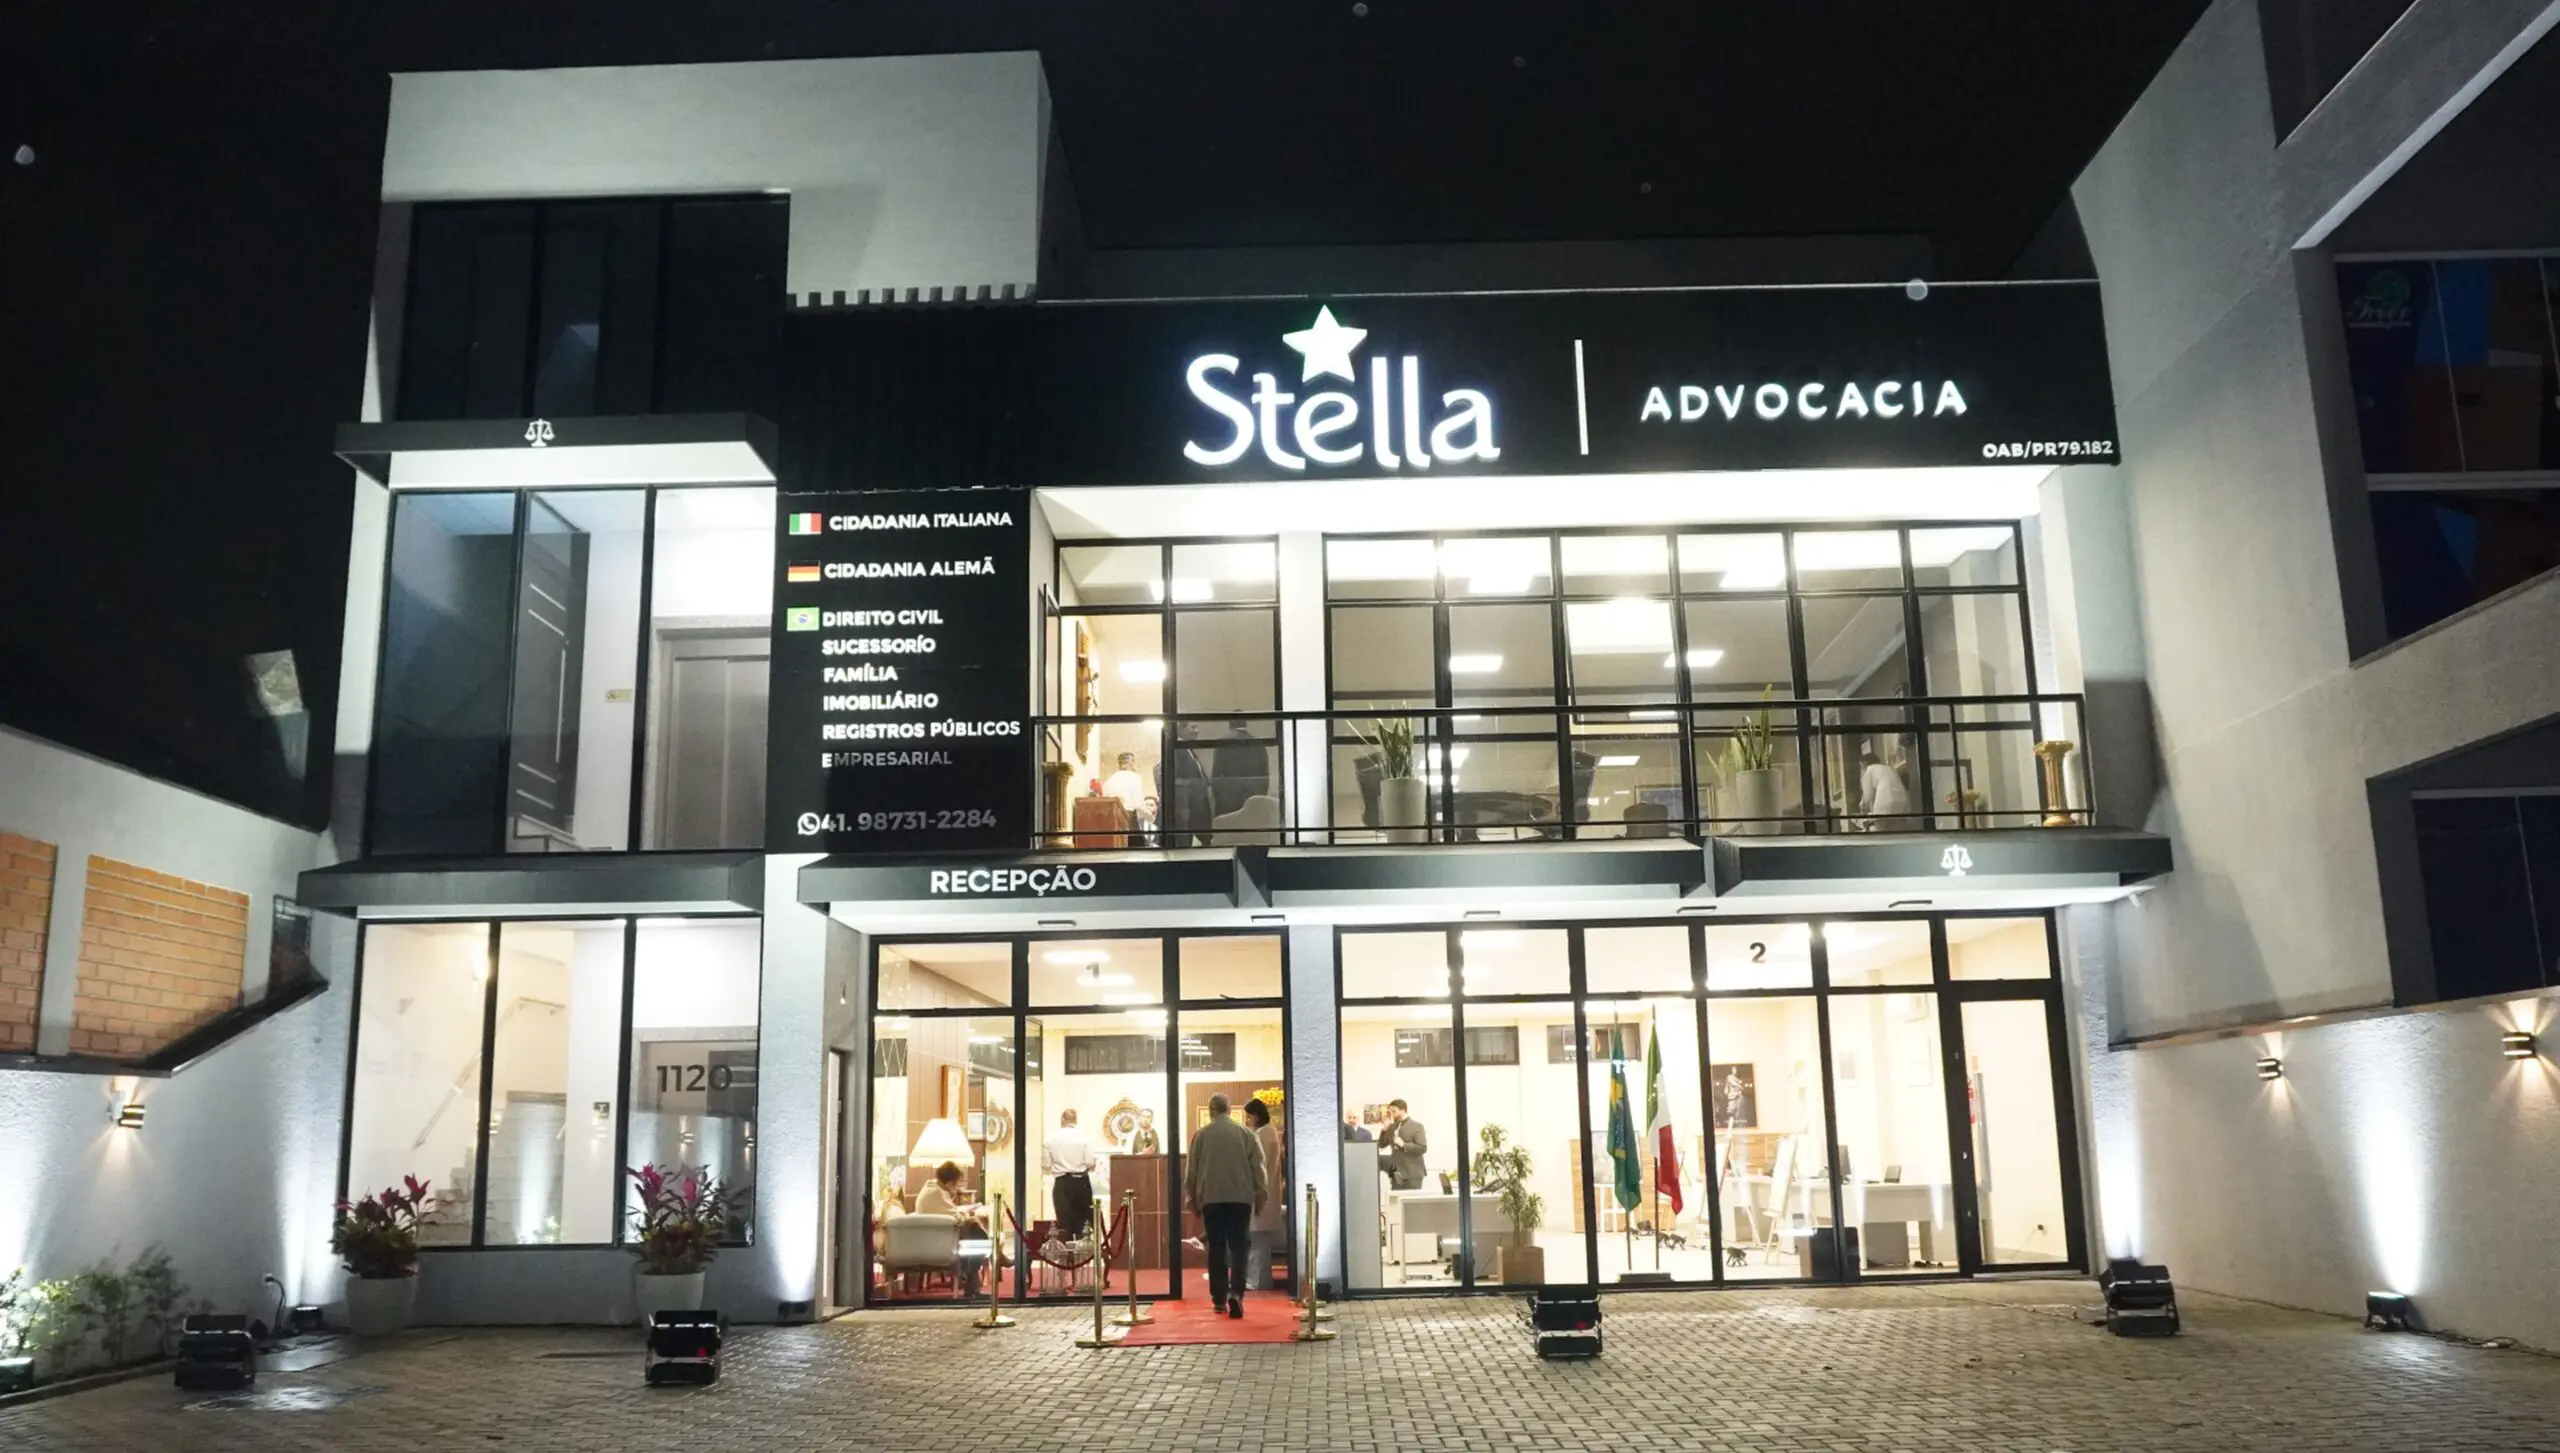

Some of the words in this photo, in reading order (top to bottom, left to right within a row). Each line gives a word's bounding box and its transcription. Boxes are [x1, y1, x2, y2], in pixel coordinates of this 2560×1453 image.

[1641, 380, 1967, 421] ADVOCACIA
[1184, 354, 1500, 469] Stella
[829, 514, 930, 531] CIDADANIA
[934, 512, 1012, 529] ITALIANA
[824, 562, 926, 579] CIDADANIA
[930, 556, 995, 577] ALEMÃ
[822, 610, 895, 627] DIREITO
[898, 610, 943, 625] CIVIL
[822, 634, 936, 655] SUCESSORÍO
[823, 662, 898, 683] FAMÍLIA
[823, 690, 939, 711] IMOBILIÁRIO
[822, 723, 925, 740] REGISTROS
[930, 718, 1021, 738] PÚBLICOS
[821, 751, 953, 769] EMPRESARIAL
[857, 809, 997, 831] 98731-2284
[930, 865, 1097, 897] RECEPÇÃO
[1749, 942, 1766, 963] 2
[656, 1064, 733, 1092] 1120
